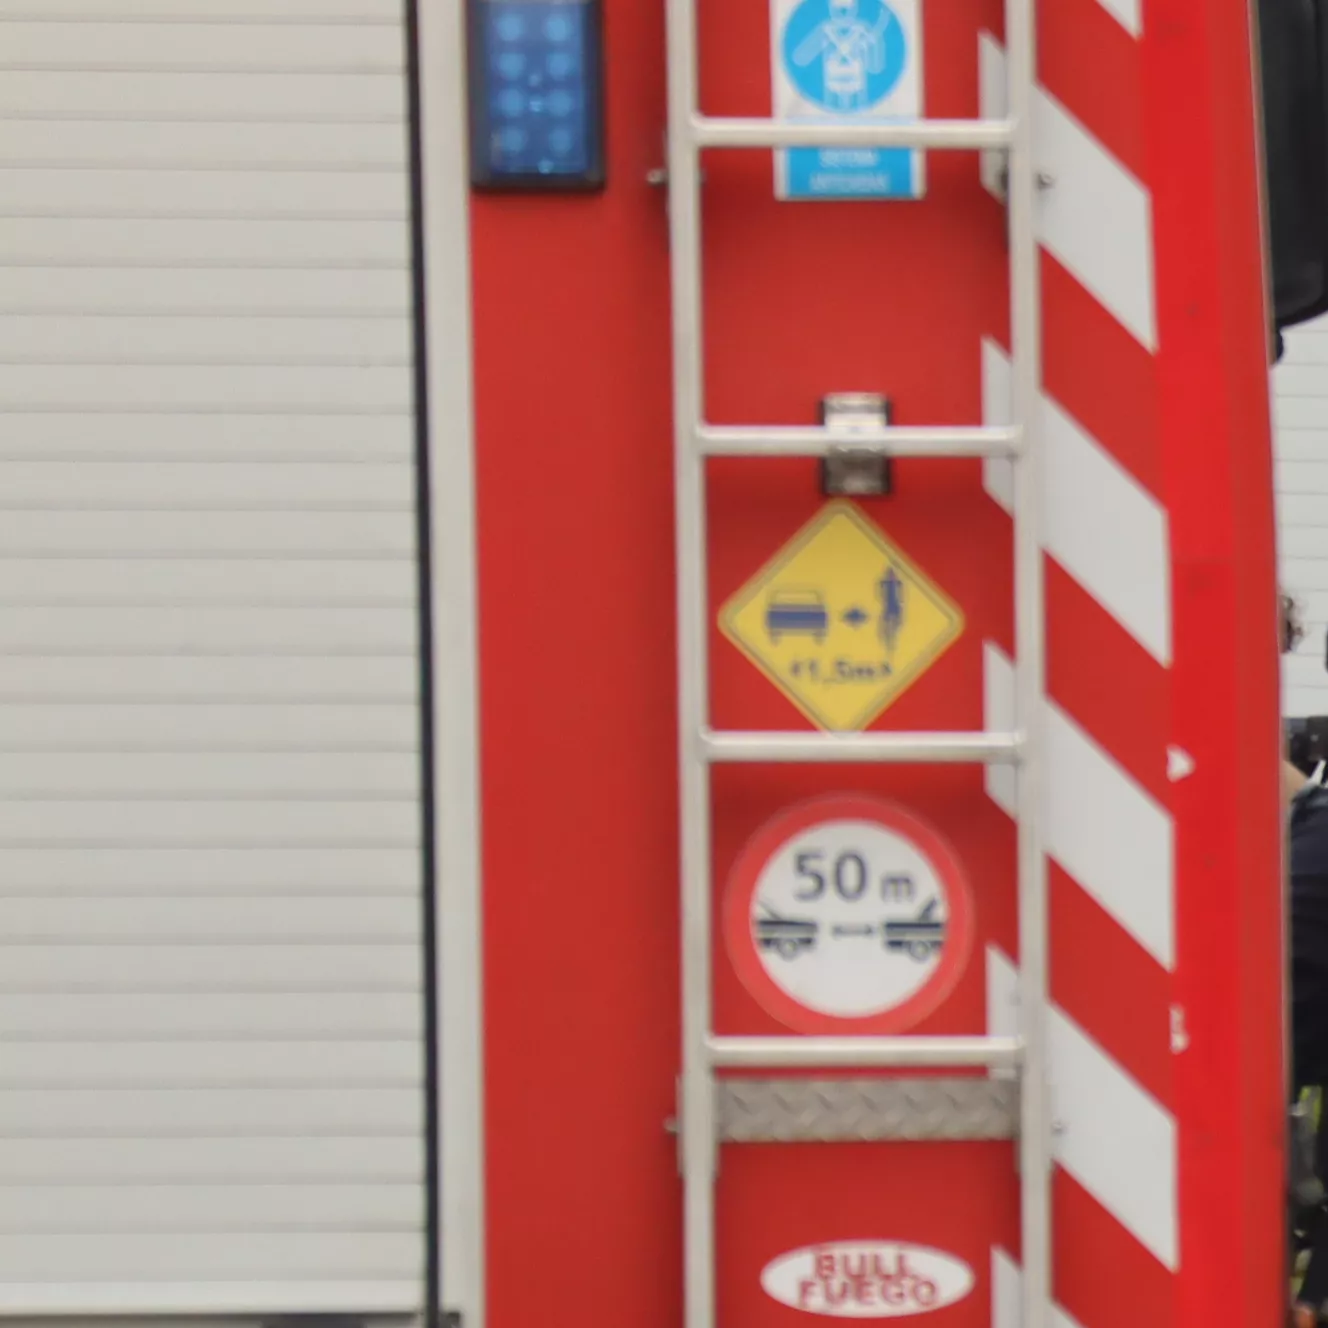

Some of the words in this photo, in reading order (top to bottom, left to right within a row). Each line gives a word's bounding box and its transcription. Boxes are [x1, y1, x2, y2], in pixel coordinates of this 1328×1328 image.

[793, 851, 868, 902] 50
[879, 873, 918, 903] m
[814, 1250, 910, 1280] BULL
[798, 1279, 938, 1306] FUEGO
